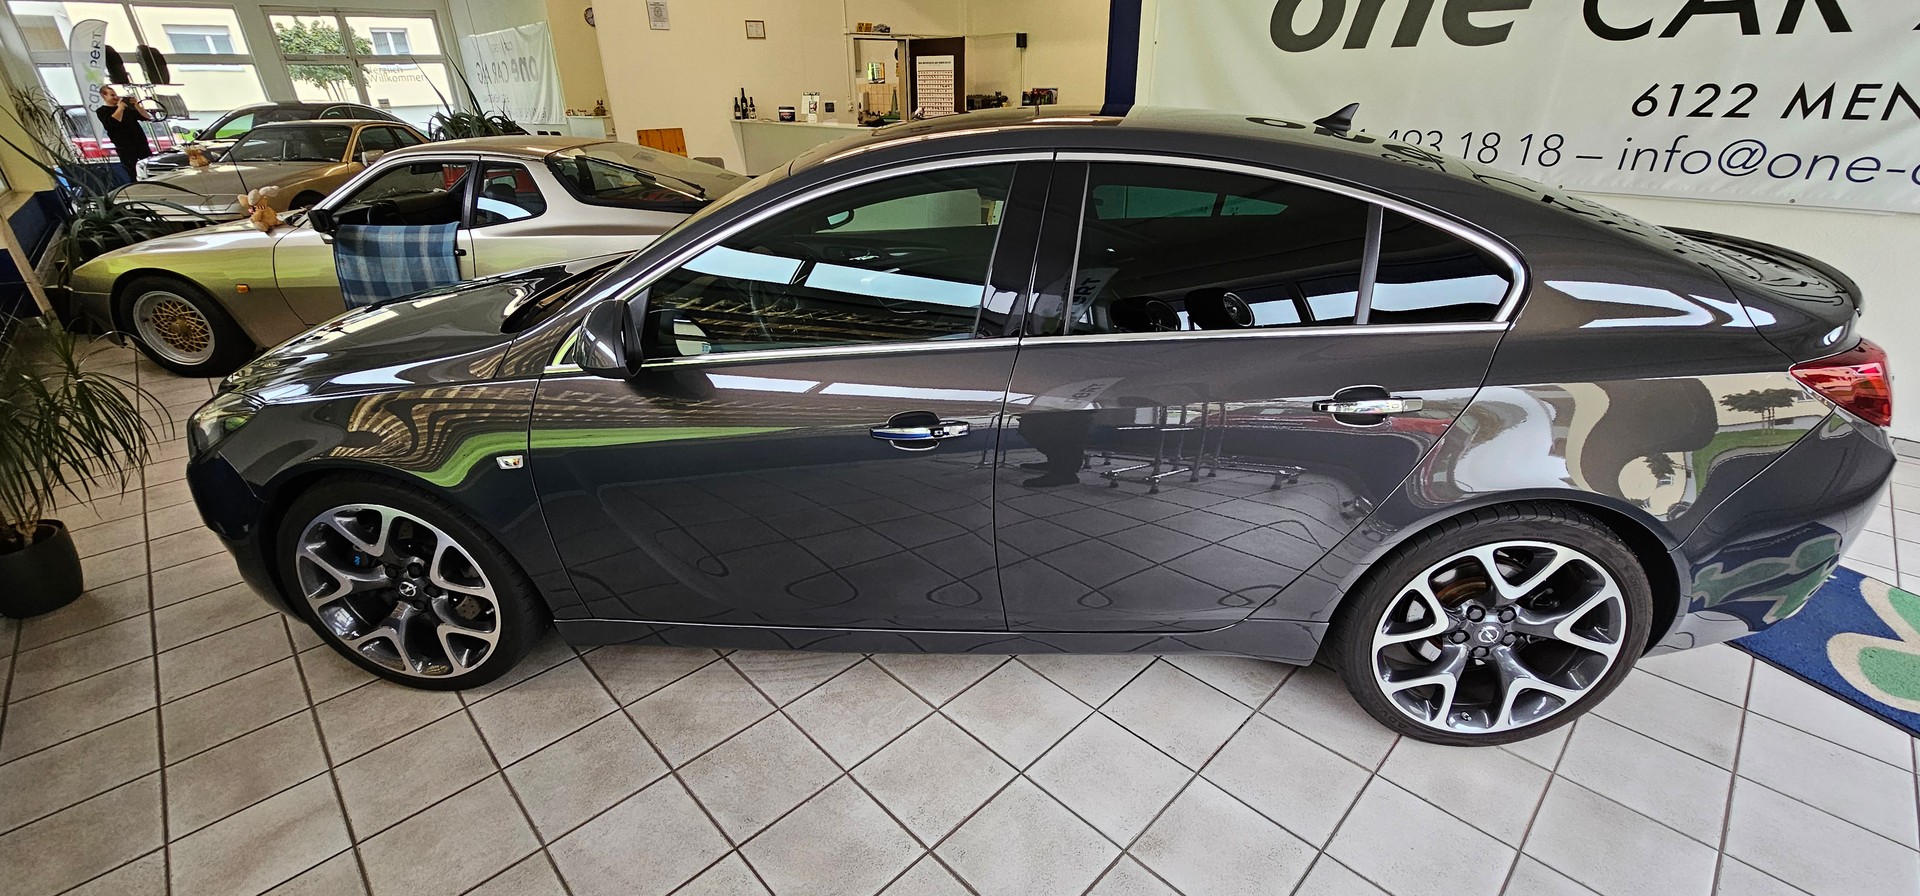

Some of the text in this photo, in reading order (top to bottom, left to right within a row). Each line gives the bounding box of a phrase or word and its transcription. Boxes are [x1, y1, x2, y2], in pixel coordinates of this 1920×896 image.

[1269, 0, 1532, 52] one
[1631, 82, 1759, 119] 6122
[1460, 131, 1501, 164] 18
[1519, 132, 1565, 168] 18
[1616, 135, 1920, 187] info@one-
